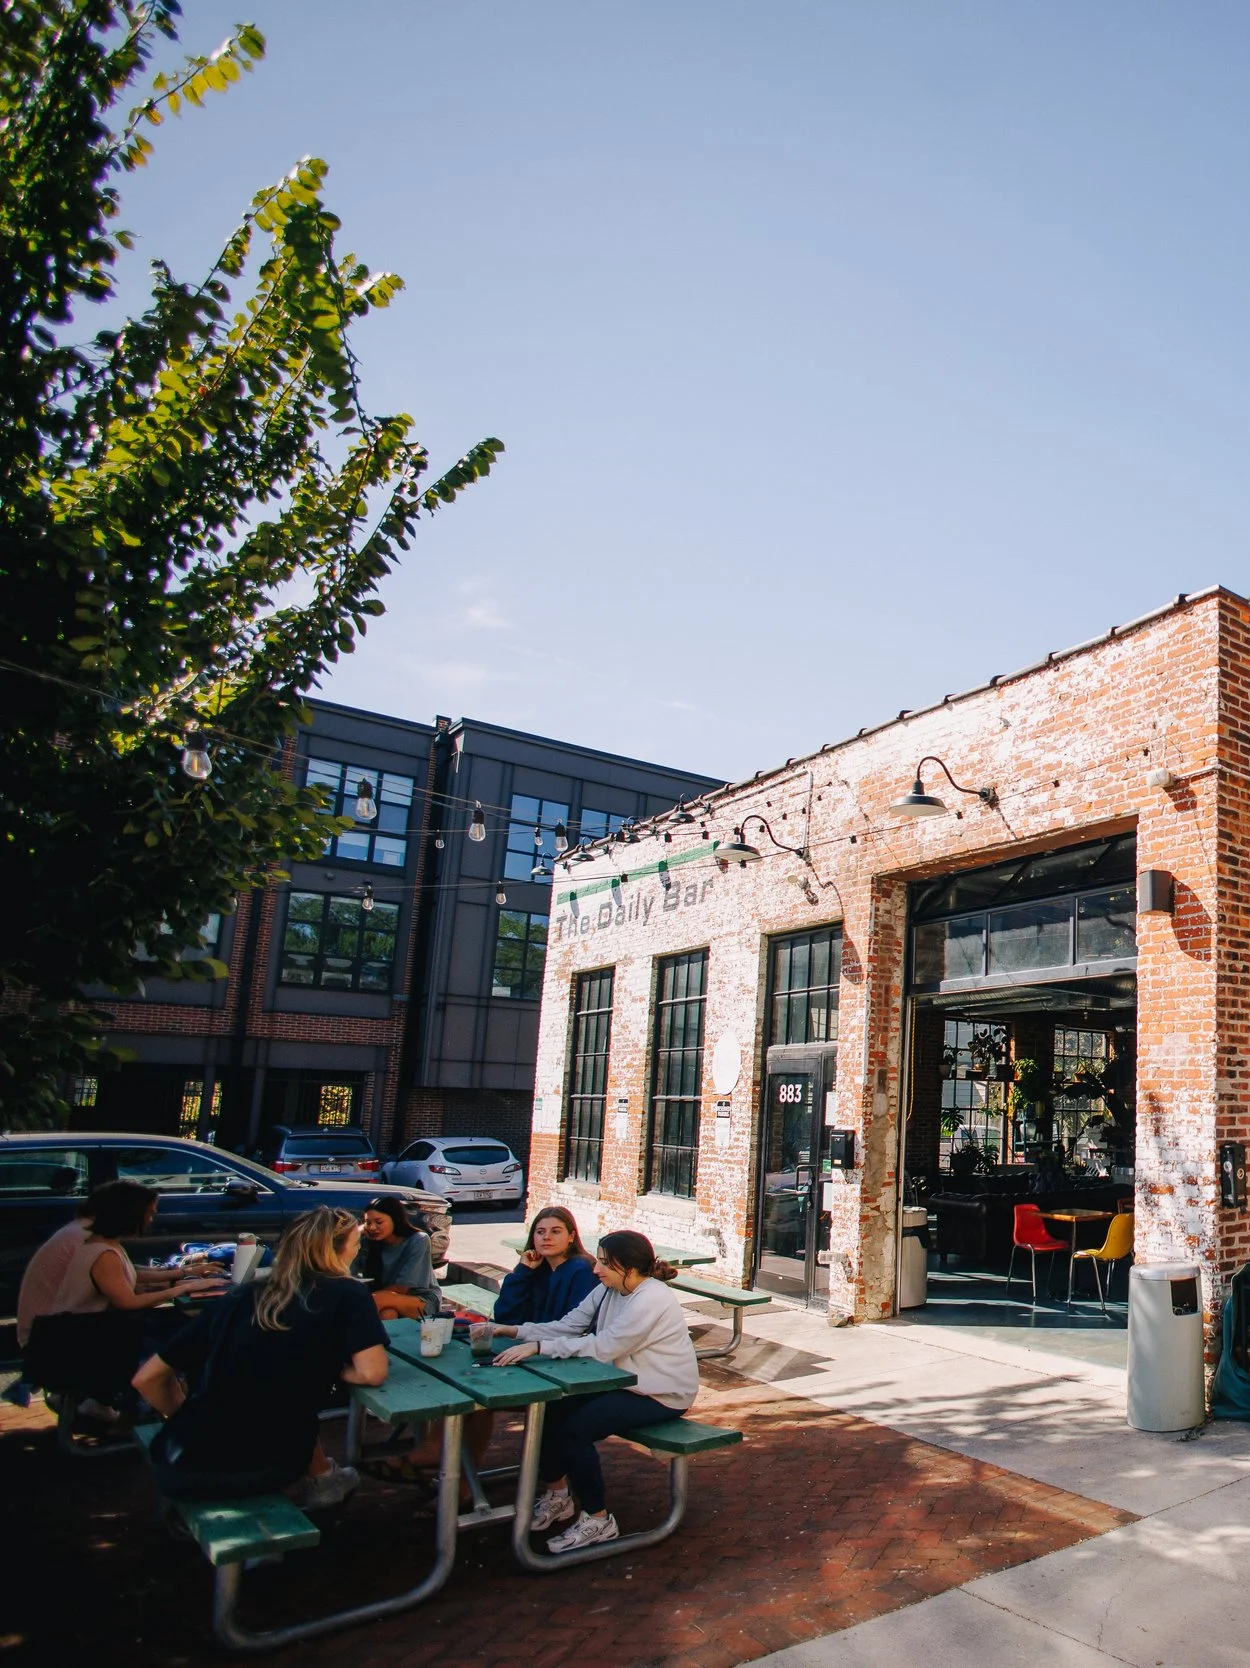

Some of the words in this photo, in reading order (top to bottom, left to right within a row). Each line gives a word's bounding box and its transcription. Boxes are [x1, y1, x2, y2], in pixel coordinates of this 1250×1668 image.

[556, 913, 590, 941] The
[597, 892, 655, 929] Daily
[663, 878, 714, 912] Bar
[779, 1084, 802, 1103] 883
